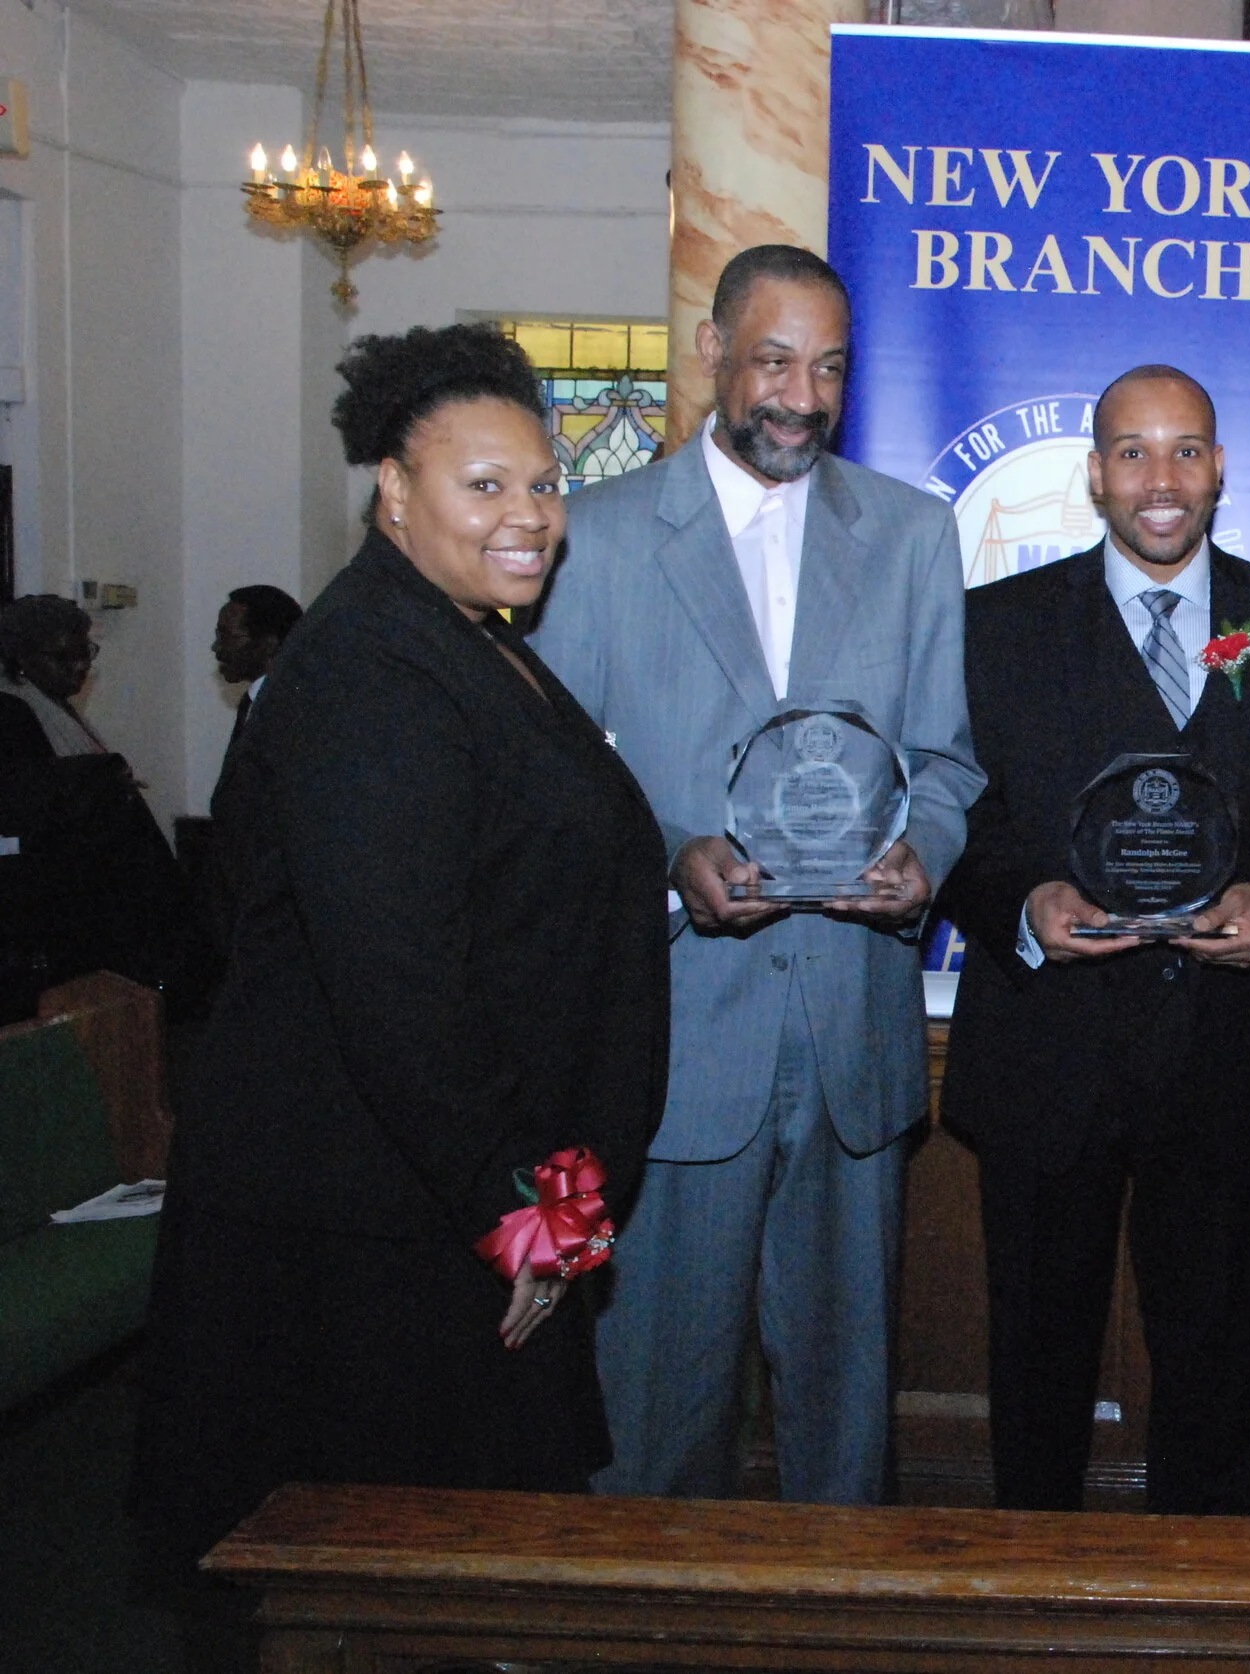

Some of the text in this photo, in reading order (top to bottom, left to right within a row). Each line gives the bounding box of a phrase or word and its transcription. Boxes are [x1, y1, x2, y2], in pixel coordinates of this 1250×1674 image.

[860, 144, 1061, 209] NEW
[954, 423, 1006, 471] FOR
[1016, 402, 1063, 438] THE
[1121, 849, 1188, 858] Randolph McGee
